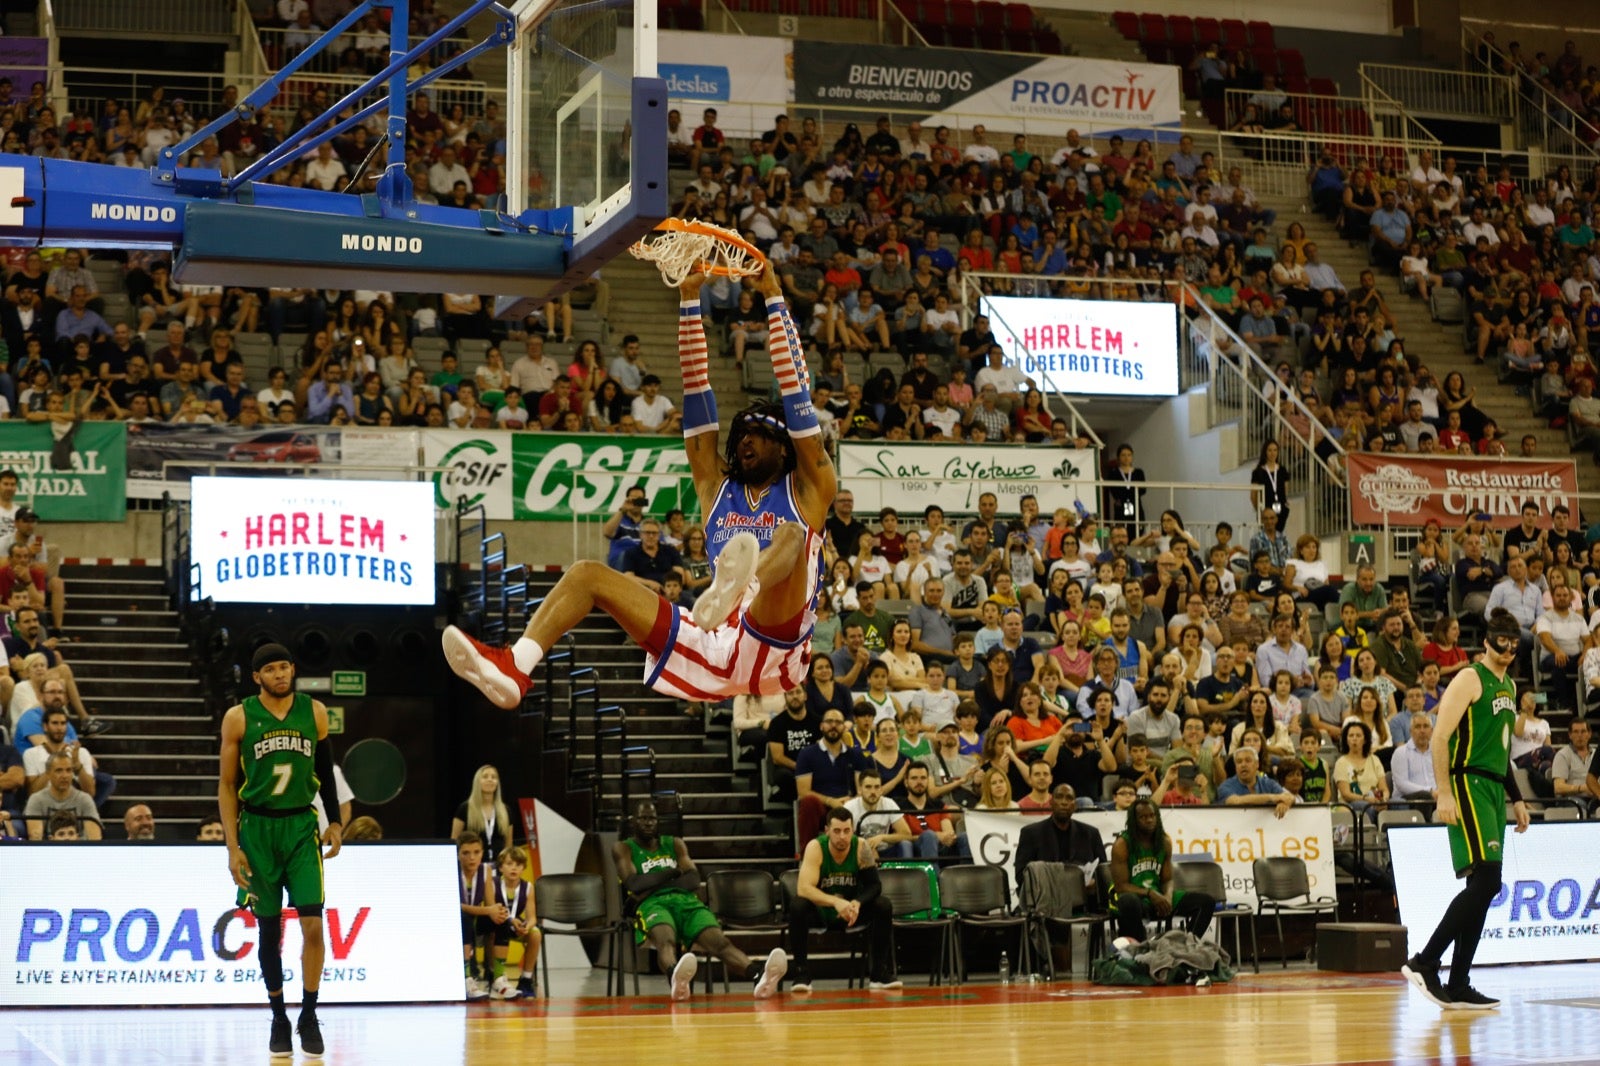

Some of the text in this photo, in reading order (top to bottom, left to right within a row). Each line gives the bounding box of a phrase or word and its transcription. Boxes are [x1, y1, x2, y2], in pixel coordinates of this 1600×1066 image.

[783, 18, 794, 33] 3
[665, 73, 719, 94] deslas
[849, 64, 973, 91] BIENVENIDOS
[817, 87, 826, 98] a
[828, 85, 852, 98] otro
[926, 90, 942, 103] de
[1011, 78, 1156, 111] PROACTIV
[91, 203, 176, 223] MONDO
[341, 234, 423, 254] MONDO
[1024, 324, 1123, 355] HARLEM
[446, 460, 507, 487] CSIF
[524, 442, 690, 513] CSIF
[901, 480, 928, 492] 1990
[1445, 468, 1562, 488] Restaurante
[1442, 486, 1569, 516] CHIKITO
[245, 512, 384, 552] HARLEM
[1355, 543, 1370, 563] A
[216, 551, 413, 586] GLOBETROTTERS
[253, 735, 312, 760] GENERALS
[271, 763, 293, 796] 7
[15, 907, 372, 963] PROACV
[1480, 927, 1504, 940] IVE
[15, 967, 367, 985] LIVE ENTERTAINMENT & BRAD ENTS
